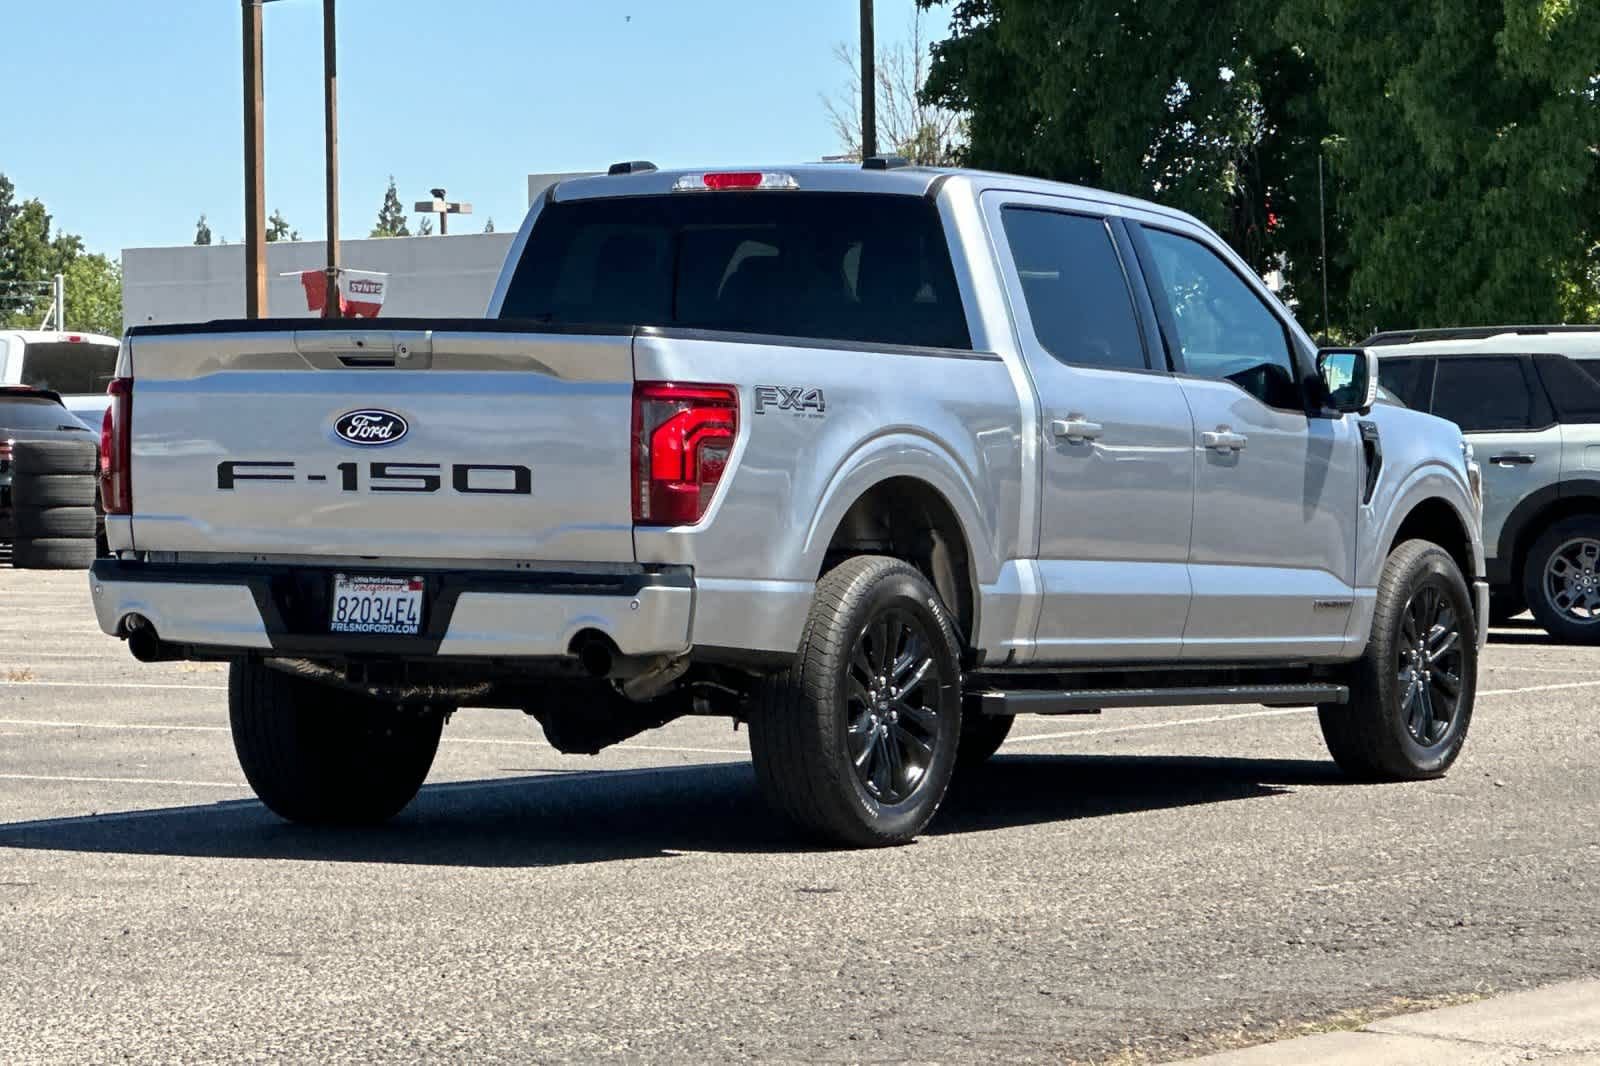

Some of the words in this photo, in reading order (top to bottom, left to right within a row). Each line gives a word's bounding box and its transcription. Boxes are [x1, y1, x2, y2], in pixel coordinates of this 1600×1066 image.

[753, 384, 825, 414] FX4
[346, 414, 394, 439] Ford
[217, 461, 531, 494] F-150
[337, 596, 416, 624] 82034E4
[331, 622, 418, 634] FRESNOFORD.COM
